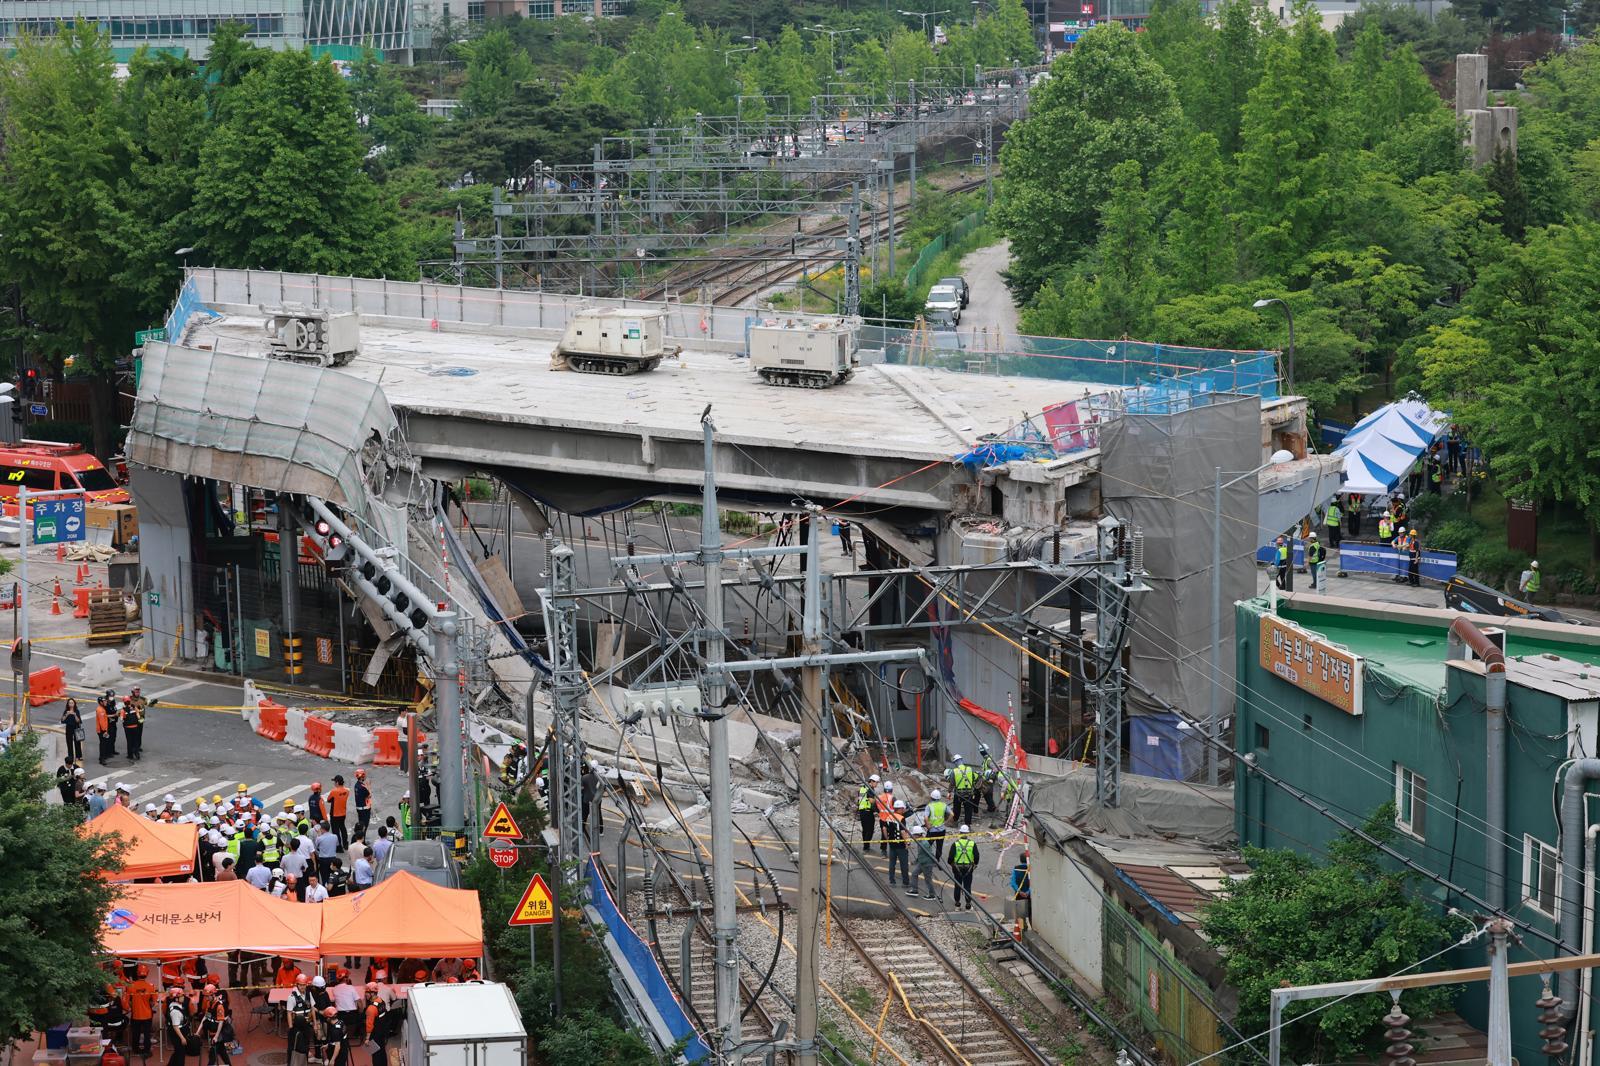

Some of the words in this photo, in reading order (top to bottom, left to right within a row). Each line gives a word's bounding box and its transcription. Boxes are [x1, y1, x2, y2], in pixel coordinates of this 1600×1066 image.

[8, 470, 25, 481] 119
[494, 855, 514, 863] STOP
[528, 900, 547, 910] 위험
[142, 911, 221, 924] 서대문소방서
